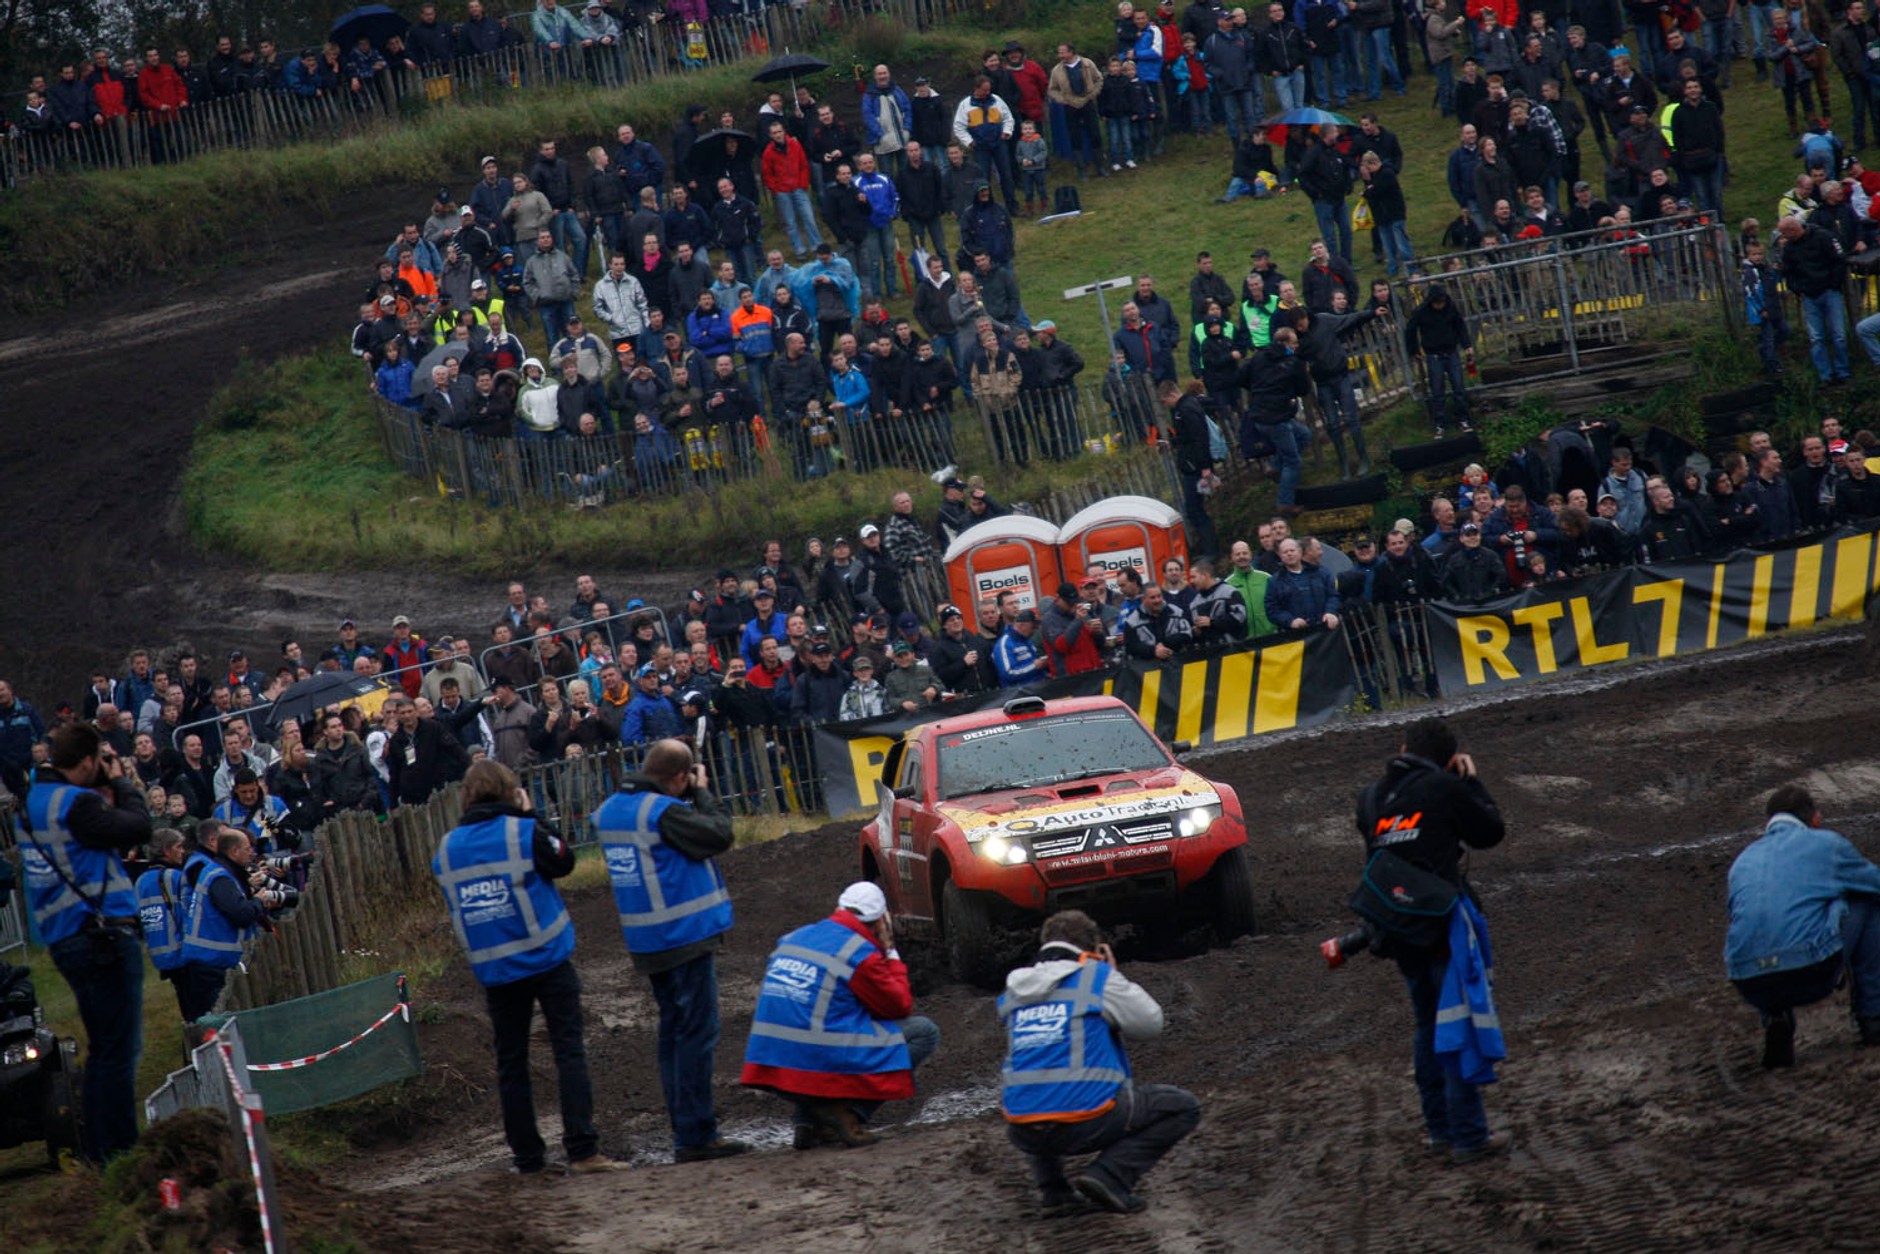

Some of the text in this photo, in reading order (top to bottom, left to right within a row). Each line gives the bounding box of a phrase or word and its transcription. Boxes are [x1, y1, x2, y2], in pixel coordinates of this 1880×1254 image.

[979, 575, 1029, 591] Boels
[1456, 578, 1684, 685] RTL 7
[461, 879, 508, 899] MEDIA
[772, 958, 817, 978] MEDIA
[1016, 1003, 1066, 1023] MEDIA
